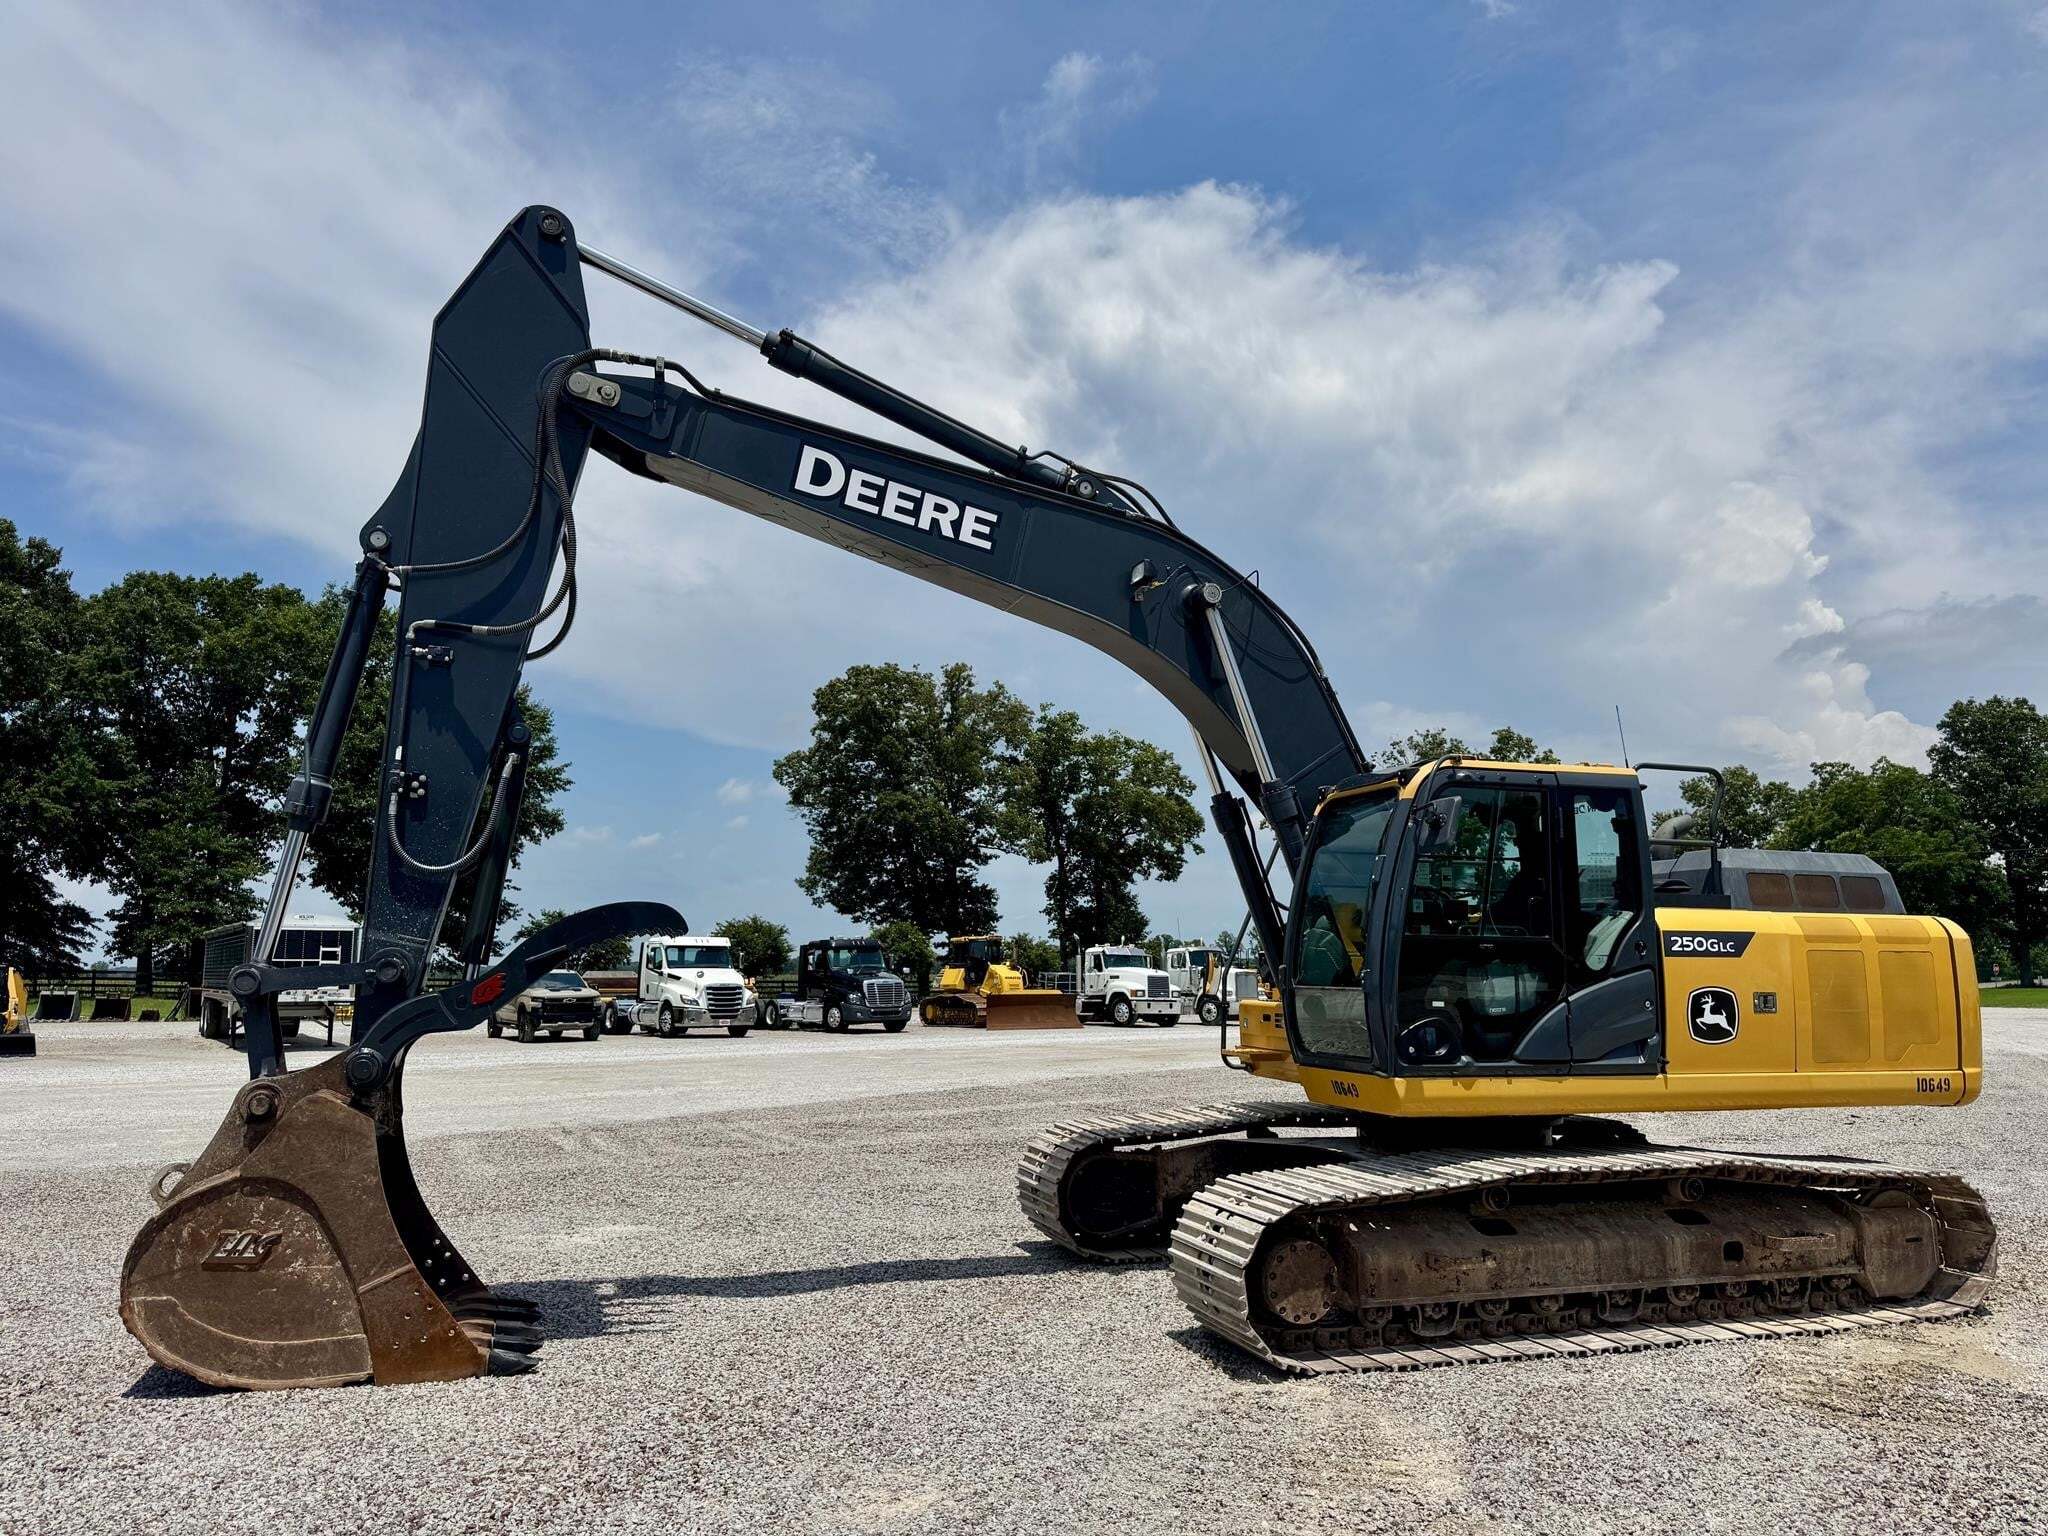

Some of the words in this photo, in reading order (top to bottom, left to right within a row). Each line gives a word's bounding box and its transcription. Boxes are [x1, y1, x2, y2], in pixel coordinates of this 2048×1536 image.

[795, 445, 998, 550] DEERE
[1670, 936, 1735, 952] 250GLC
[1331, 1080, 1359, 1098] 10649
[1917, 1077, 1950, 1093] 10649
